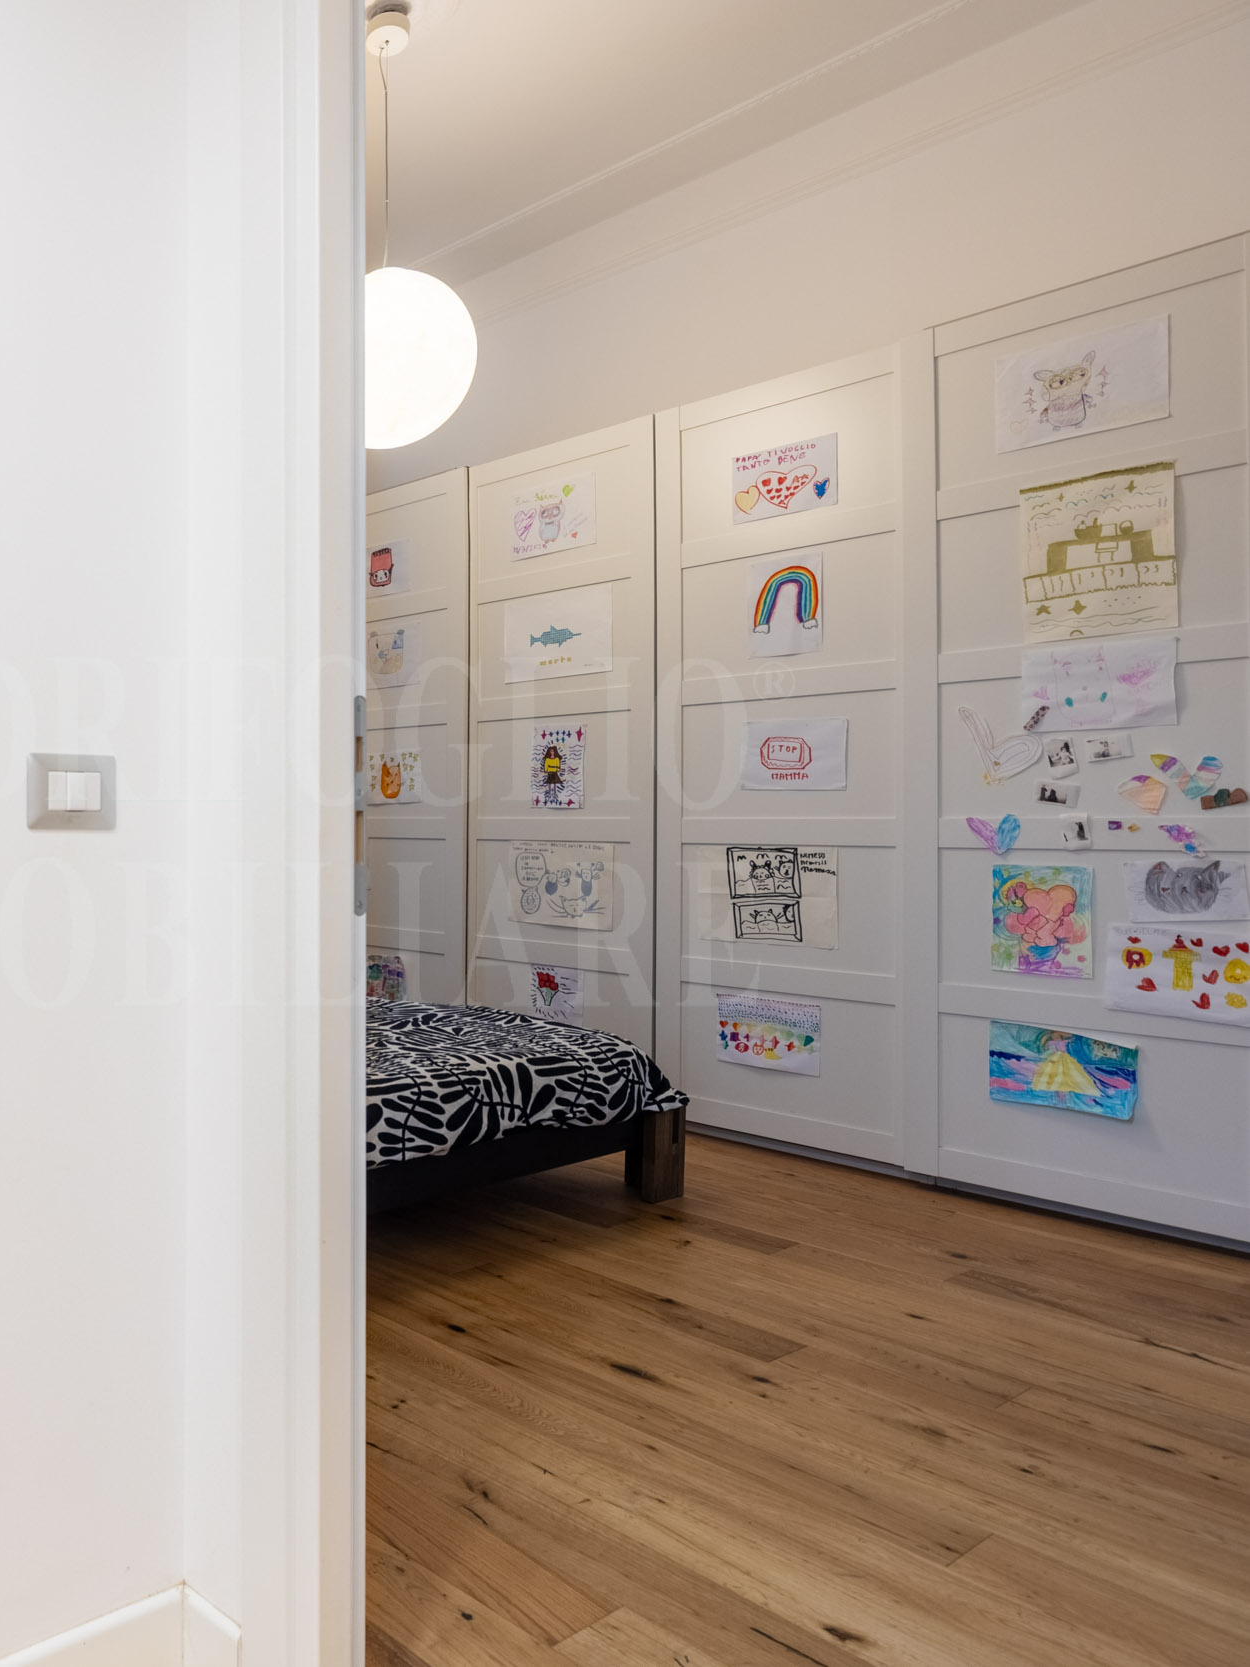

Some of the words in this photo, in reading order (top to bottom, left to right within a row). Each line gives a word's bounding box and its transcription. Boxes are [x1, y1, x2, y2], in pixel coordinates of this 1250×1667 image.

[767, 448, 778, 458] TI
[736, 459, 771, 472] TANTO
[777, 451, 807, 466] BENE
[771, 744, 798, 754] STOP
[771, 771, 809, 781] MAMMA
